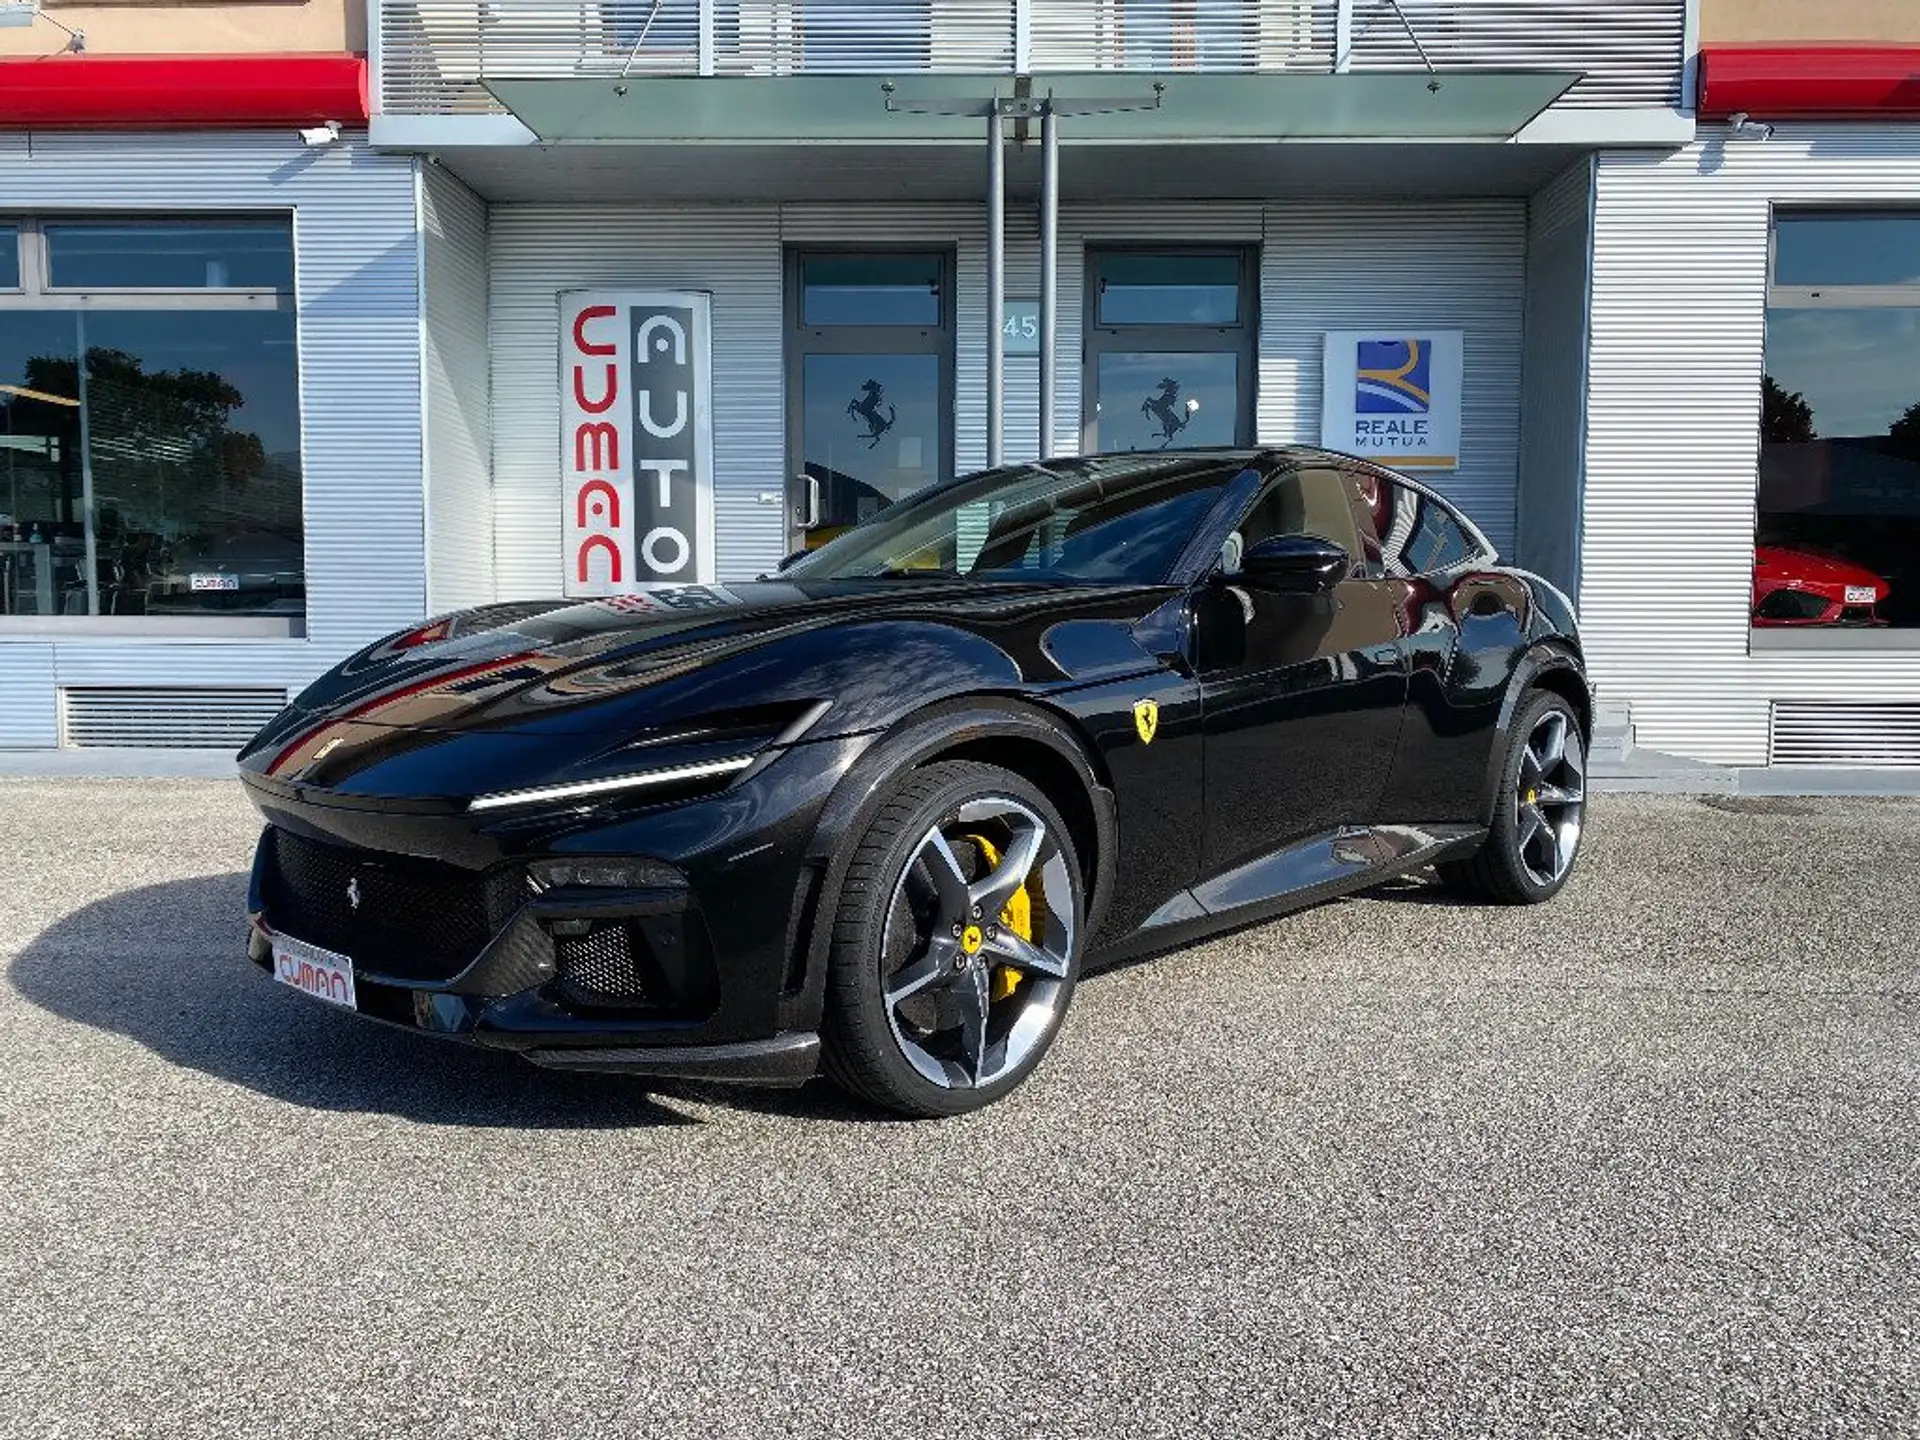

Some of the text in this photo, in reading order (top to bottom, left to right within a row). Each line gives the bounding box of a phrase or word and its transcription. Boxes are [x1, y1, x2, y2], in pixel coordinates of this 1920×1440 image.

[1003, 315, 1037, 338] 45
[573, 306, 622, 582] CUMAN
[637, 315, 690, 574] AUTO
[1355, 420, 1428, 434] REALE
[1355, 437, 1428, 447] MUTUA
[279, 954, 349, 1002] CUMAN
